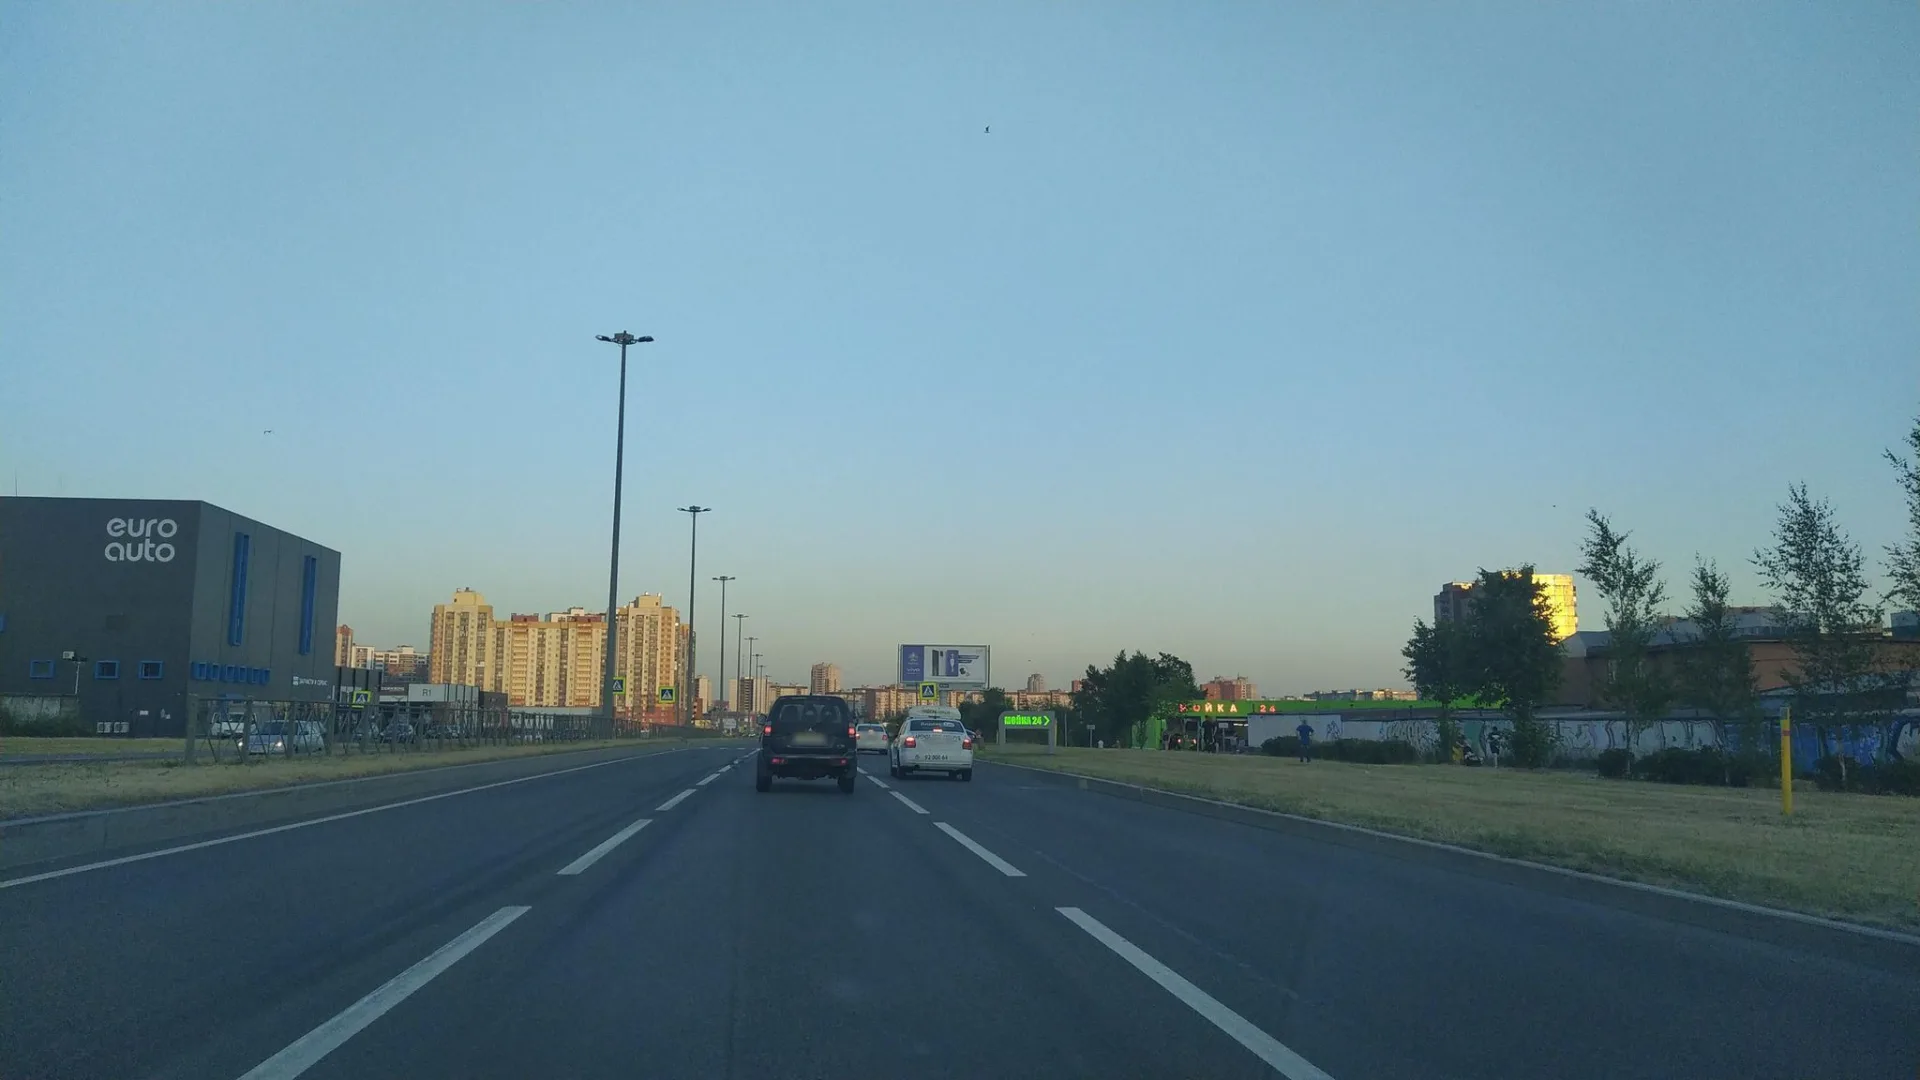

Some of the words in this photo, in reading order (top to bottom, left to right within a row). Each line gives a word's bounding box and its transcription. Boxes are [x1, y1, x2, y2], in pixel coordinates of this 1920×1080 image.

[106, 517, 178, 538] euro
[104, 538, 175, 562] auto
[422, 689, 432, 697] R1
[1179, 702, 1238, 713] МОЙКА
[1260, 704, 1276, 713] 24
[1032, 716, 1043, 725] 24
